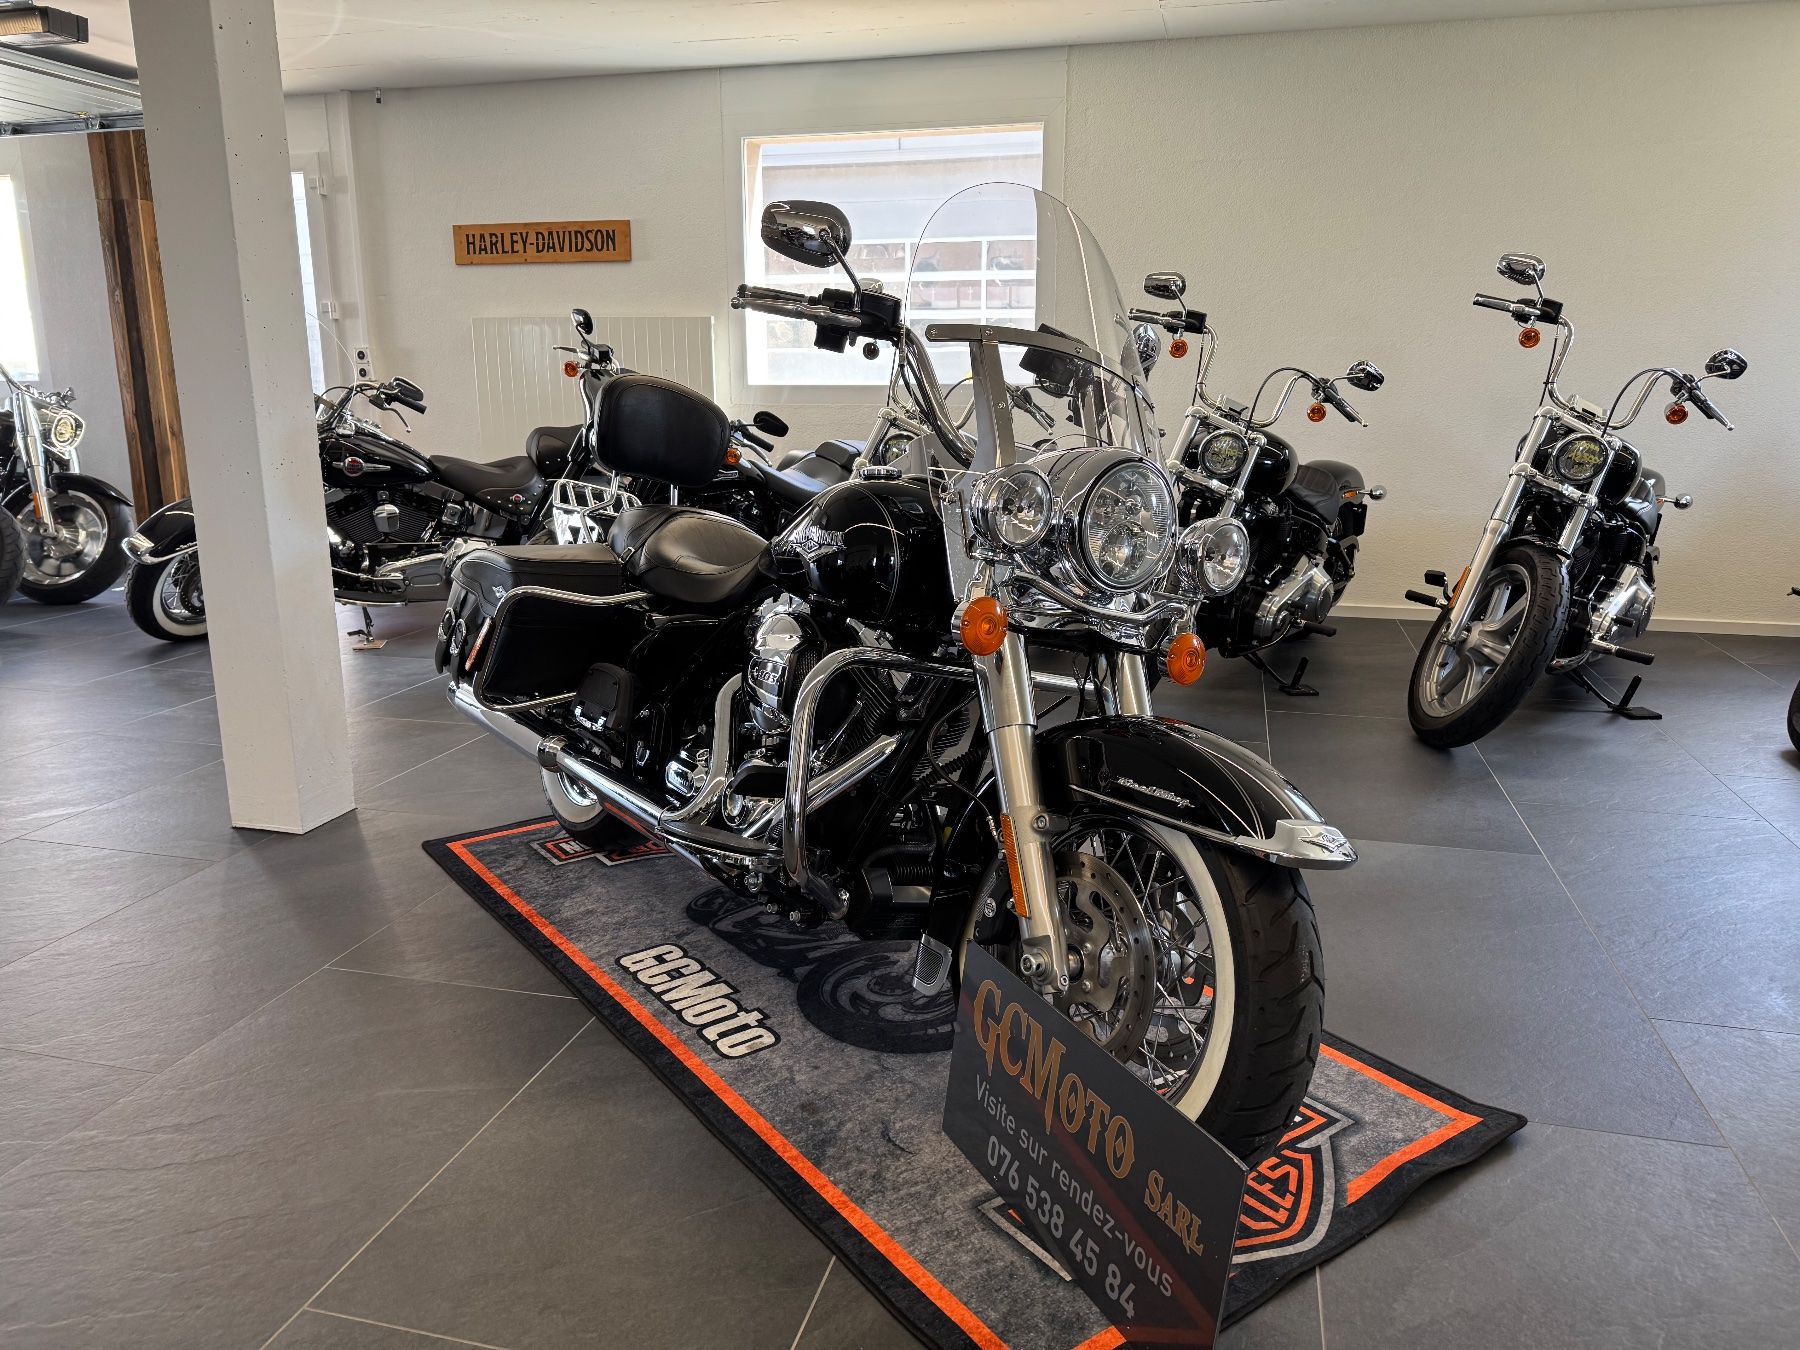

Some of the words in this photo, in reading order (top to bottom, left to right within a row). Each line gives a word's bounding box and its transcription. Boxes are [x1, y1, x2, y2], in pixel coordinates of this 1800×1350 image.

[465, 229, 617, 255] HARLEY-DAVIDSON
[619, 944, 777, 1057] GCMoto
[976, 1074, 1016, 1137] Visite
[1019, 1129, 1048, 1168] sur
[1051, 1159, 1174, 1298] rendez-vous
[986, 1135, 1019, 1191] 076
[1025, 1176, 1065, 1239] 538
[1069, 1231, 1100, 1277] 45
[1104, 1268, 1136, 1320] 84
